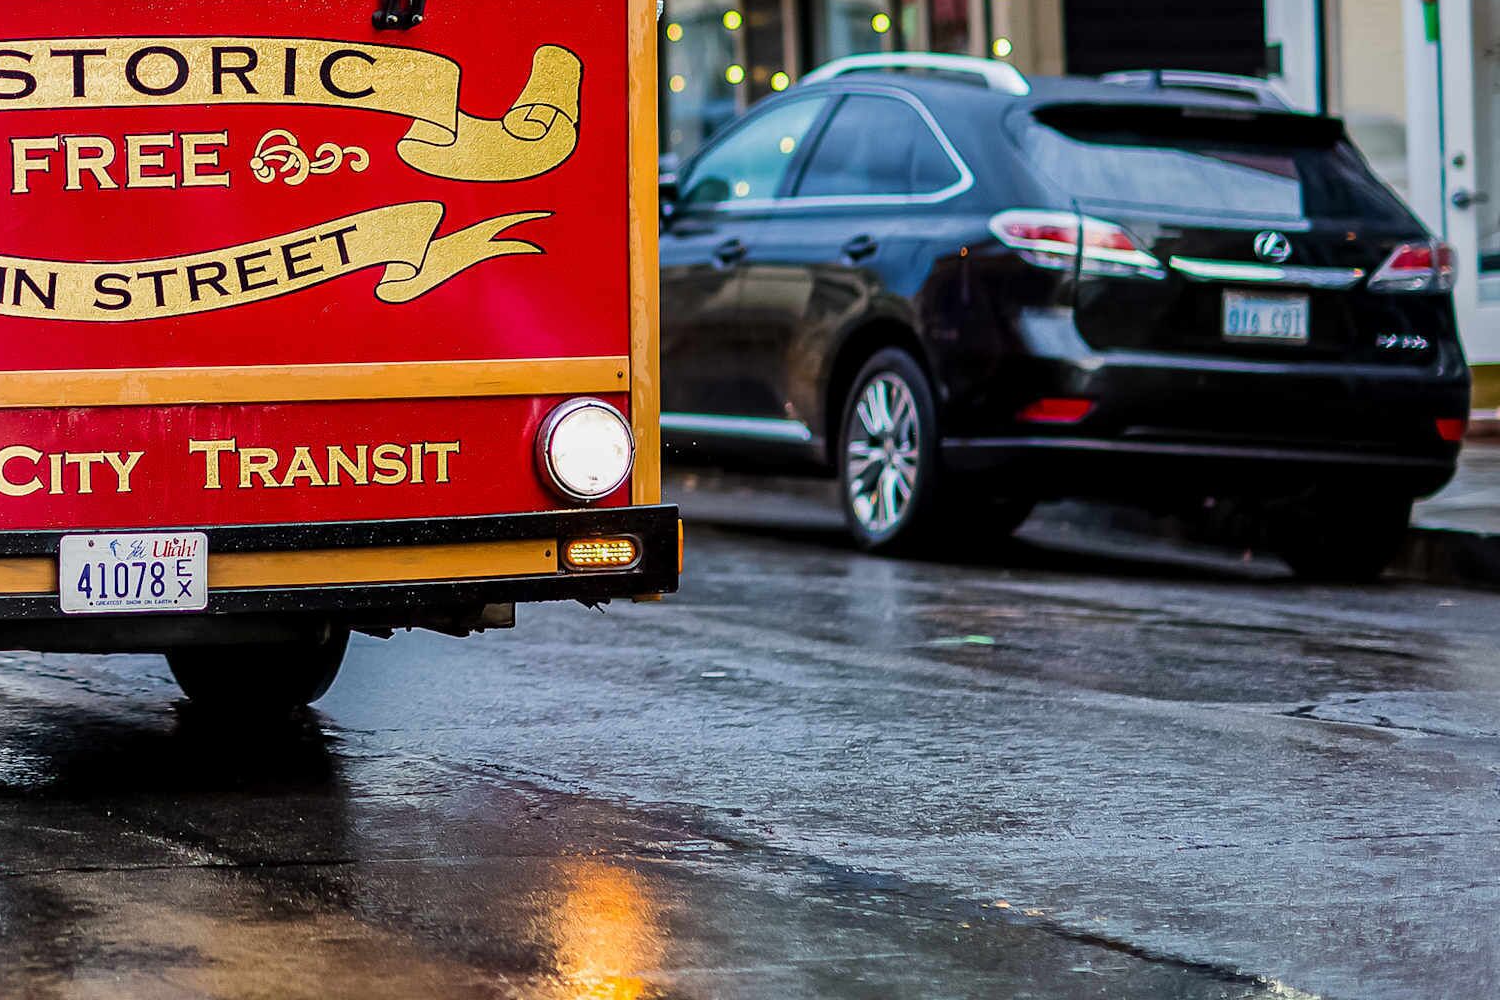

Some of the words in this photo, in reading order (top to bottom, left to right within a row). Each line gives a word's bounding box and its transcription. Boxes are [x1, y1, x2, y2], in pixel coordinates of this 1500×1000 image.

[10, 129, 231, 196] FREE
[92, 223, 359, 311] STREET
[189, 437, 461, 490] TRANSIT
[152, 538, 198, 558] Utah!
[77, 561, 165, 599] 41078
